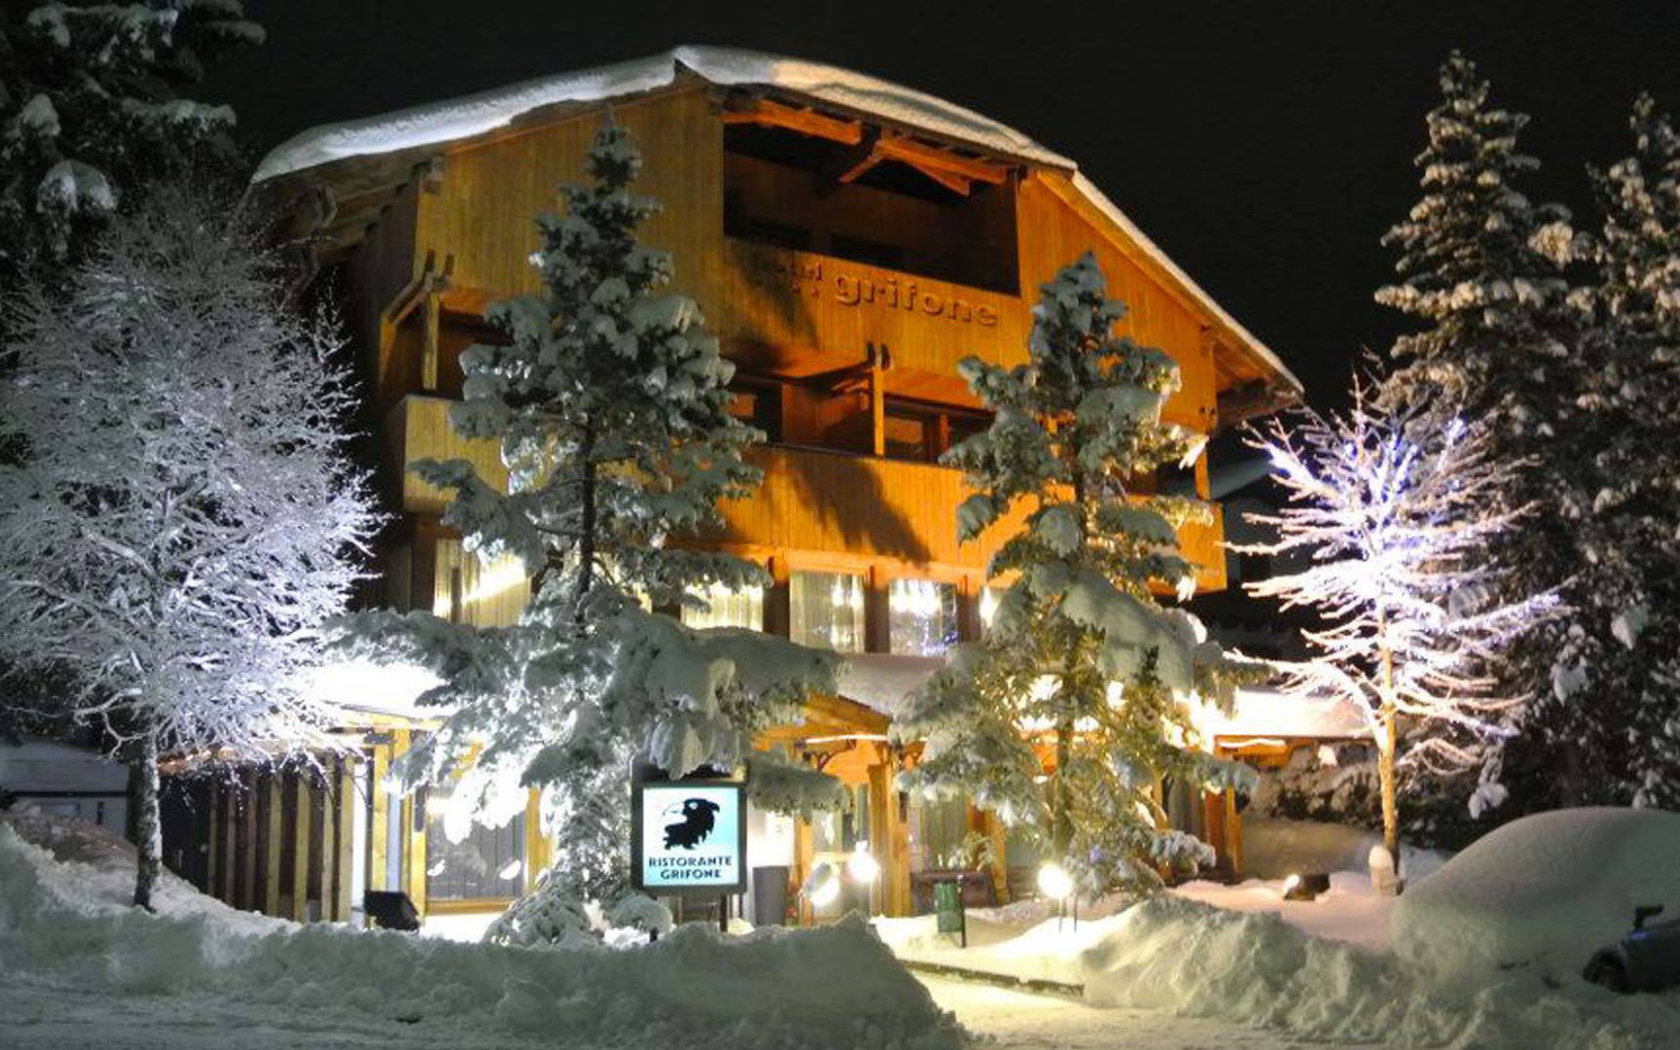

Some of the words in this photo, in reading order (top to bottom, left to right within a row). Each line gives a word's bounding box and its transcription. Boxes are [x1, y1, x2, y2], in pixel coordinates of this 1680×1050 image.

[836, 273, 998, 327] grifone
[648, 856, 732, 867] RISTORANTE
[660, 869, 722, 879] GRIFONE
